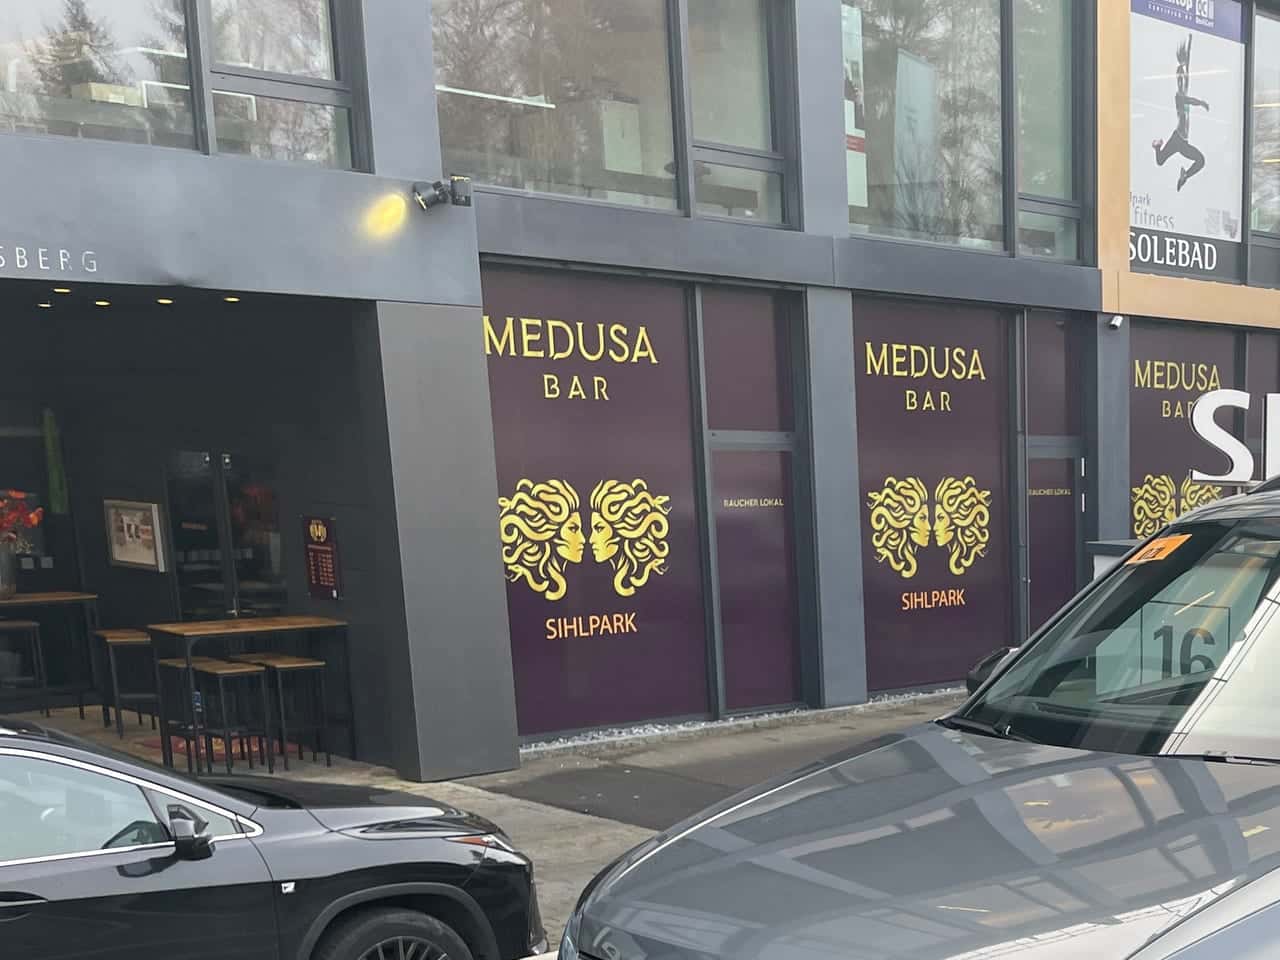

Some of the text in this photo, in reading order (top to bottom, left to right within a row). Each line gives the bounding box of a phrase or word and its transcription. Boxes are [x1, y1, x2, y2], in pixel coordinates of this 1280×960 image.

[1128, 231, 1217, 271] SOLEBAD
[482, 315, 659, 364] MEDUSA
[865, 341, 986, 380] MEDUSA
[1134, 359, 1221, 391] MEDUSA
[543, 374, 609, 400] BAR
[905, 390, 952, 411] BAR
[759, 498, 784, 507] LOKAL
[901, 589, 966, 611] SIHLPARK
[545, 612, 638, 640] SIHLPARK
[1153, 624, 1217, 680] 16
